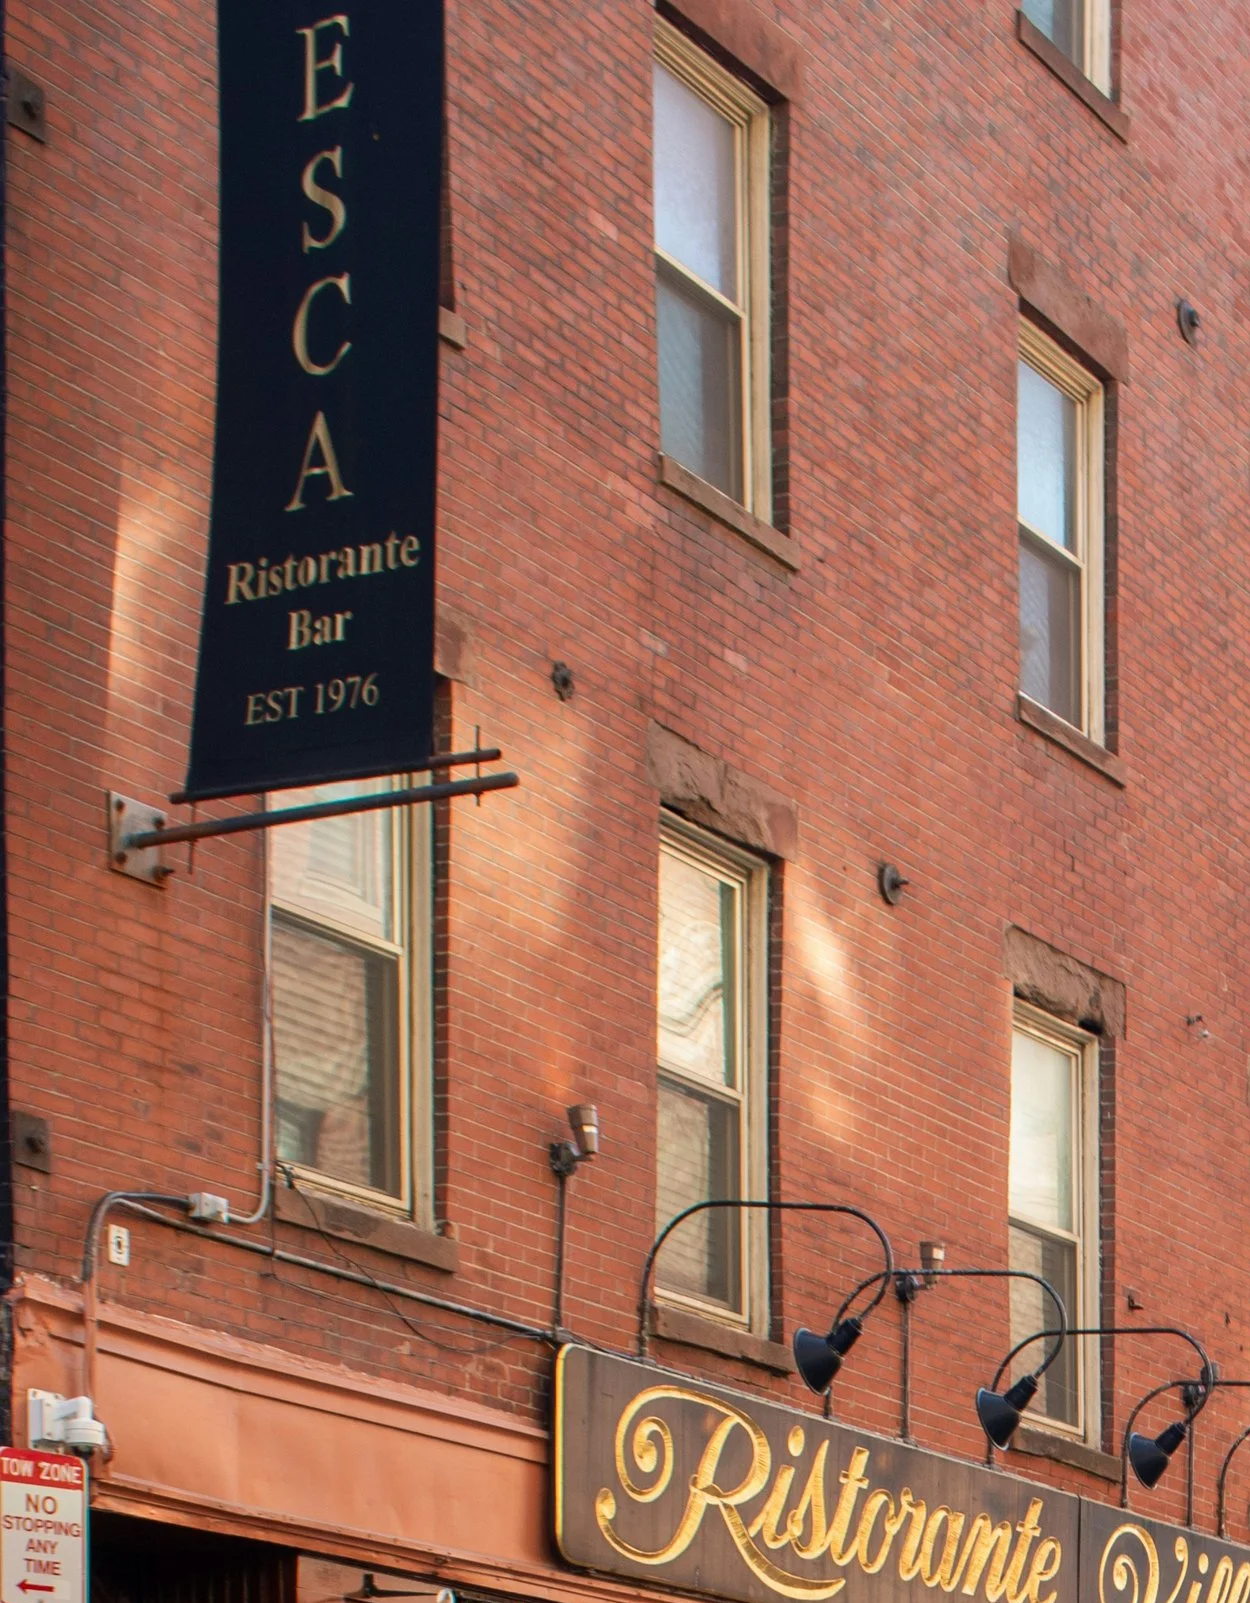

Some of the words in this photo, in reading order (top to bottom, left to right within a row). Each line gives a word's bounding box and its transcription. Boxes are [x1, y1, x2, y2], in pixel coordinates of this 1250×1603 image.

[284, 14, 355, 513] ESCA
[224, 529, 423, 607] Ristorante
[287, 605, 353, 653] Bar
[244, 685, 304, 728] EST
[313, 672, 381, 717] 1976
[1, 1457, 34, 1478] TOW
[38, 1462, 83, 1484] ZONE
[25, 1493, 59, 1515] NO
[2, 1514, 82, 1538] STOPPING
[25, 1538, 59, 1555] ANY
[23, 1557, 62, 1577] TIME
